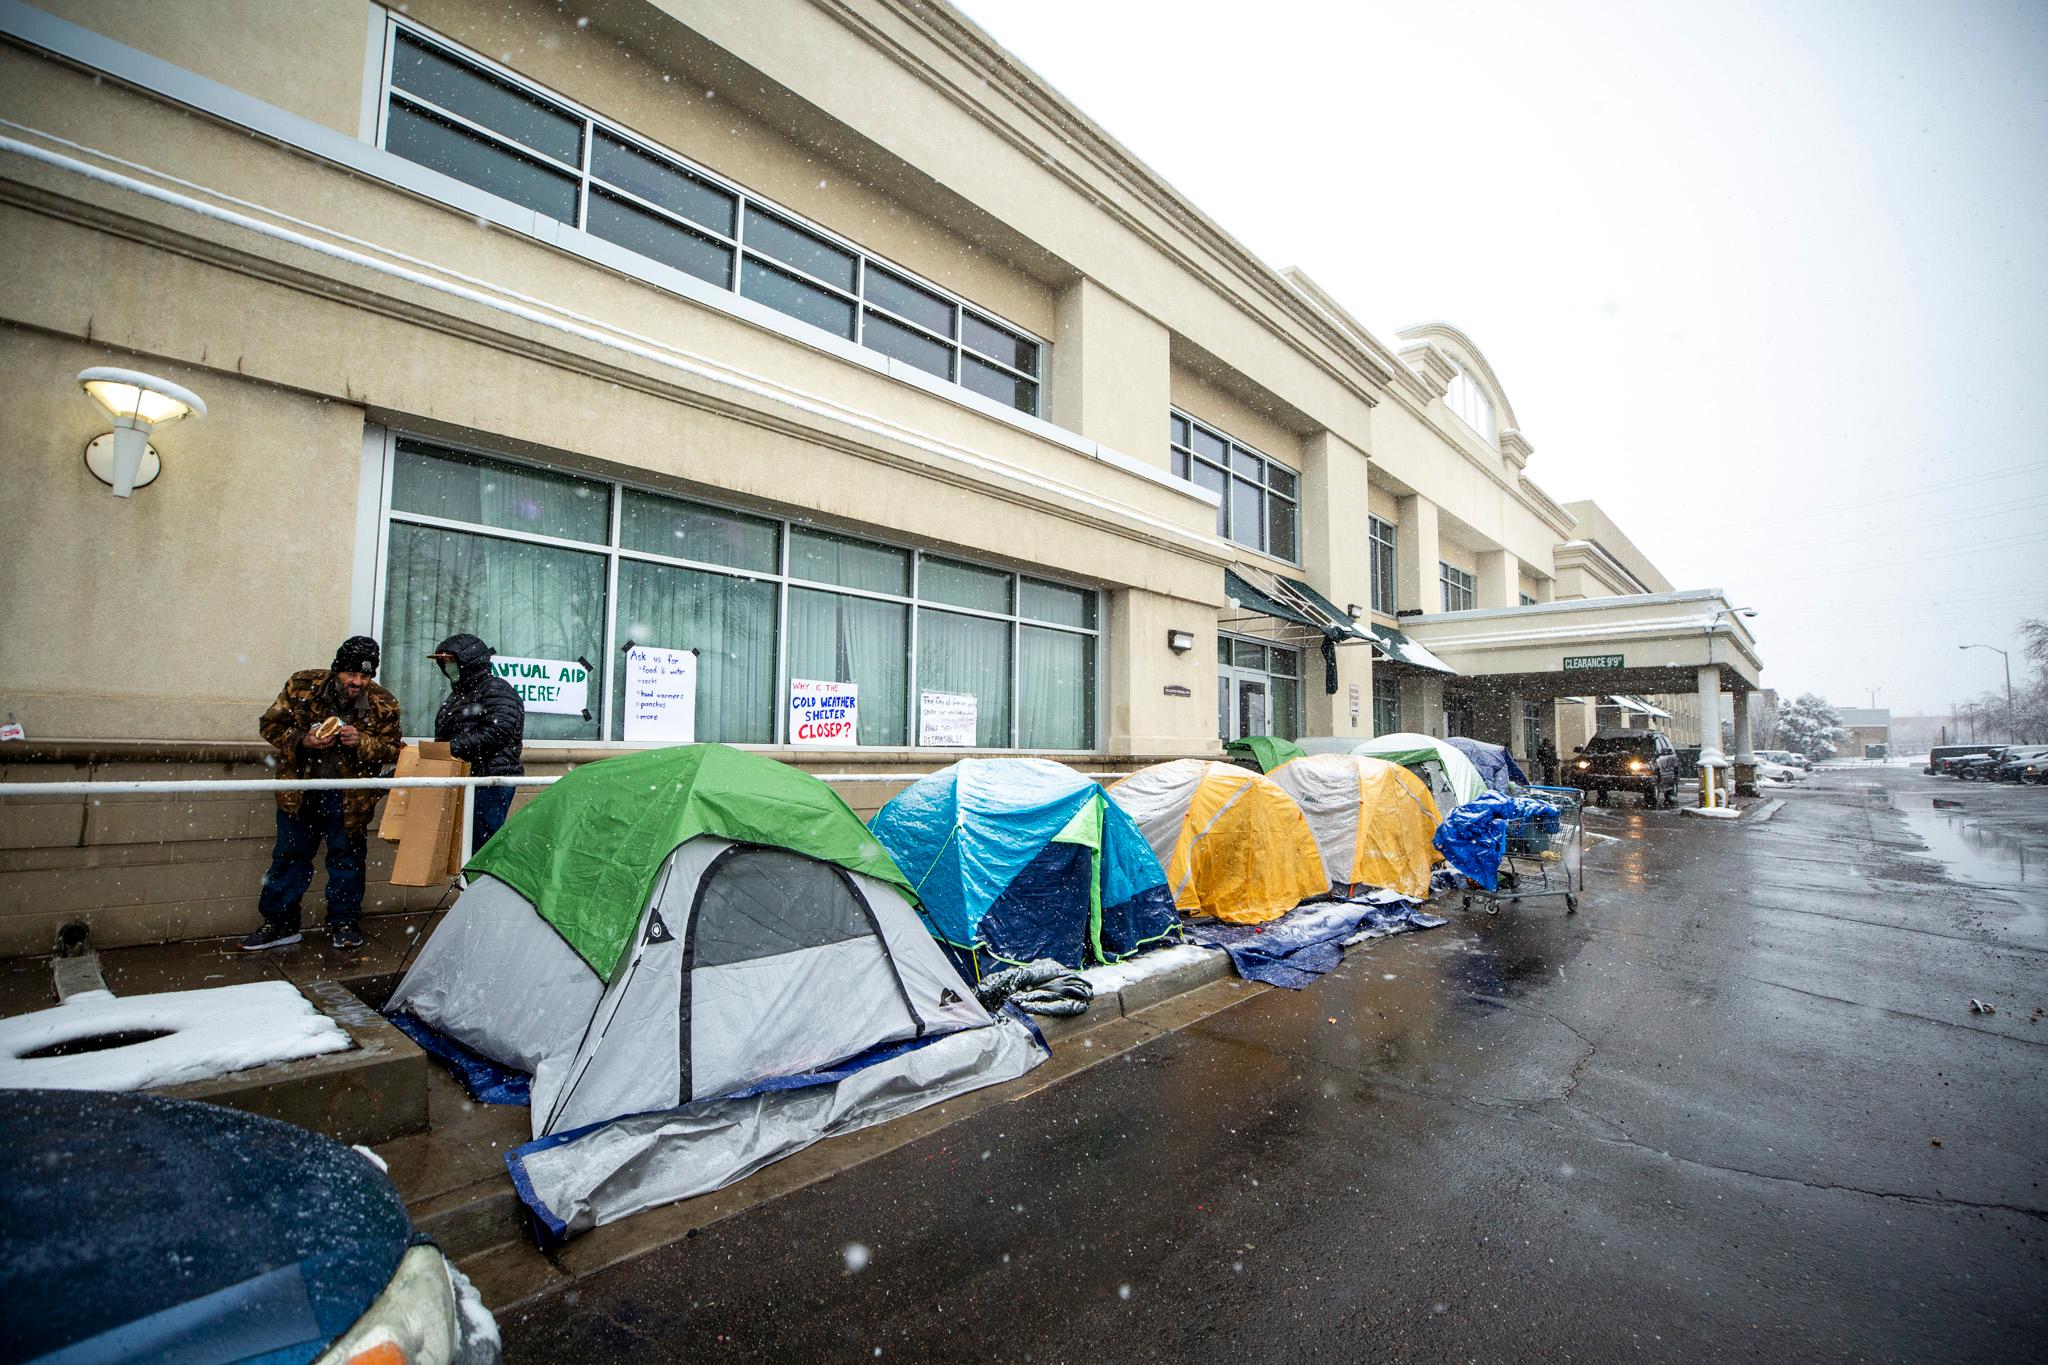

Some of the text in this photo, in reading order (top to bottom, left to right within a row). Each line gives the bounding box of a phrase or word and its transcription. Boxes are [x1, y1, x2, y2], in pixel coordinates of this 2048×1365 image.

[630, 650, 646, 661] Ask
[667, 653, 679, 664] for
[1565, 657, 1606, 669] CLEARANCE
[558, 667, 586, 683] AID
[513, 684, 561, 702] HERE!
[792, 682, 810, 691] WHY
[825, 684, 839, 693] THE
[640, 700, 666, 710] ponchos
[792, 695, 856, 710] COLD WEATHER
[805, 708, 846, 722] SHELTER
[798, 721, 852, 740] CLOSED?
